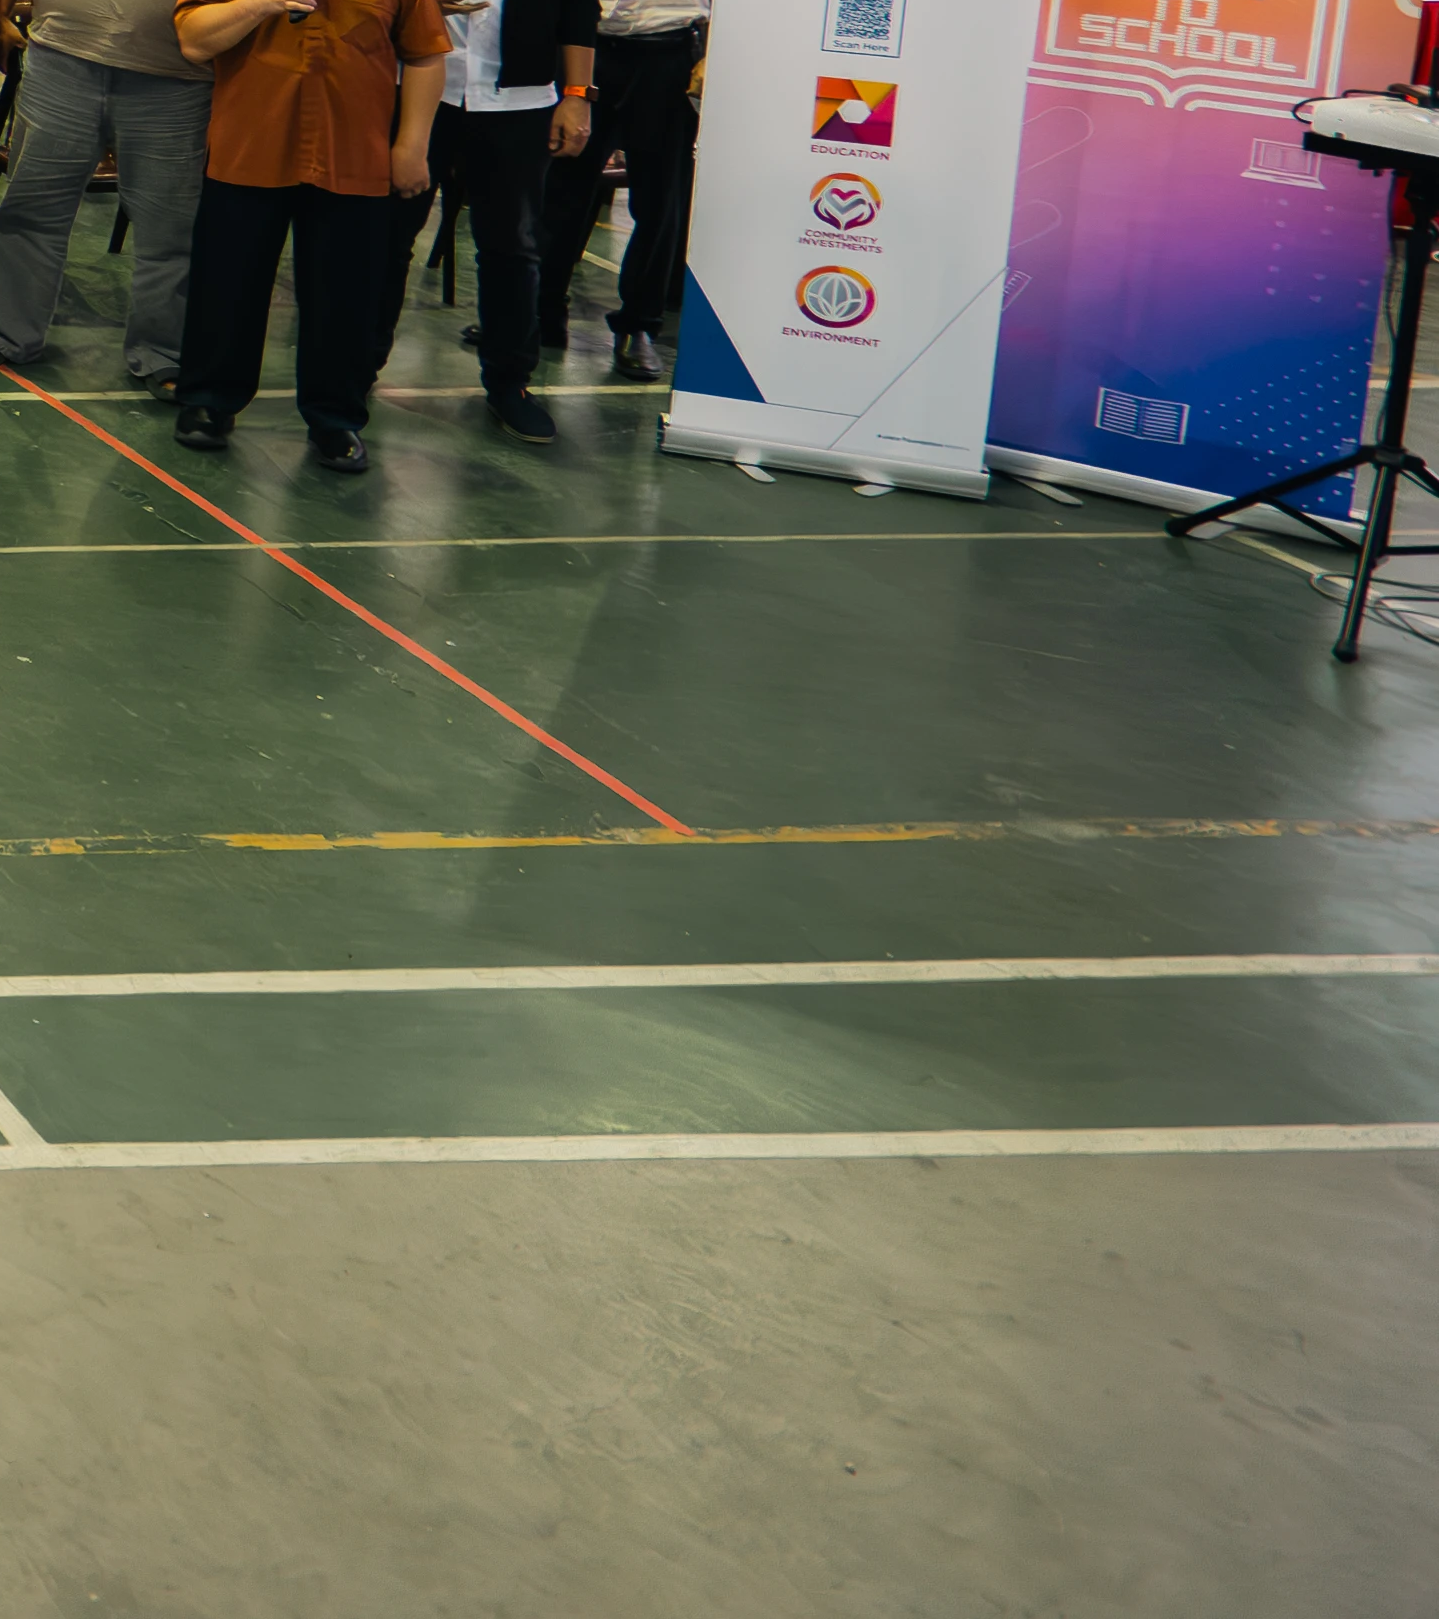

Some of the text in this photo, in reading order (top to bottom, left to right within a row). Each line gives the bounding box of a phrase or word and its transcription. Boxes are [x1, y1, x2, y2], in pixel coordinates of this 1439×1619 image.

[833, 40, 860, 50] Scan
[1078, 13, 1296, 72] SCHOOL
[811, 144, 890, 161] EDUCATION
[798, 236, 883, 254] INVESTMENTS
[805, 229, 878, 244] COMMUNITY
[782, 327, 881, 348] ENVIRONMENT
